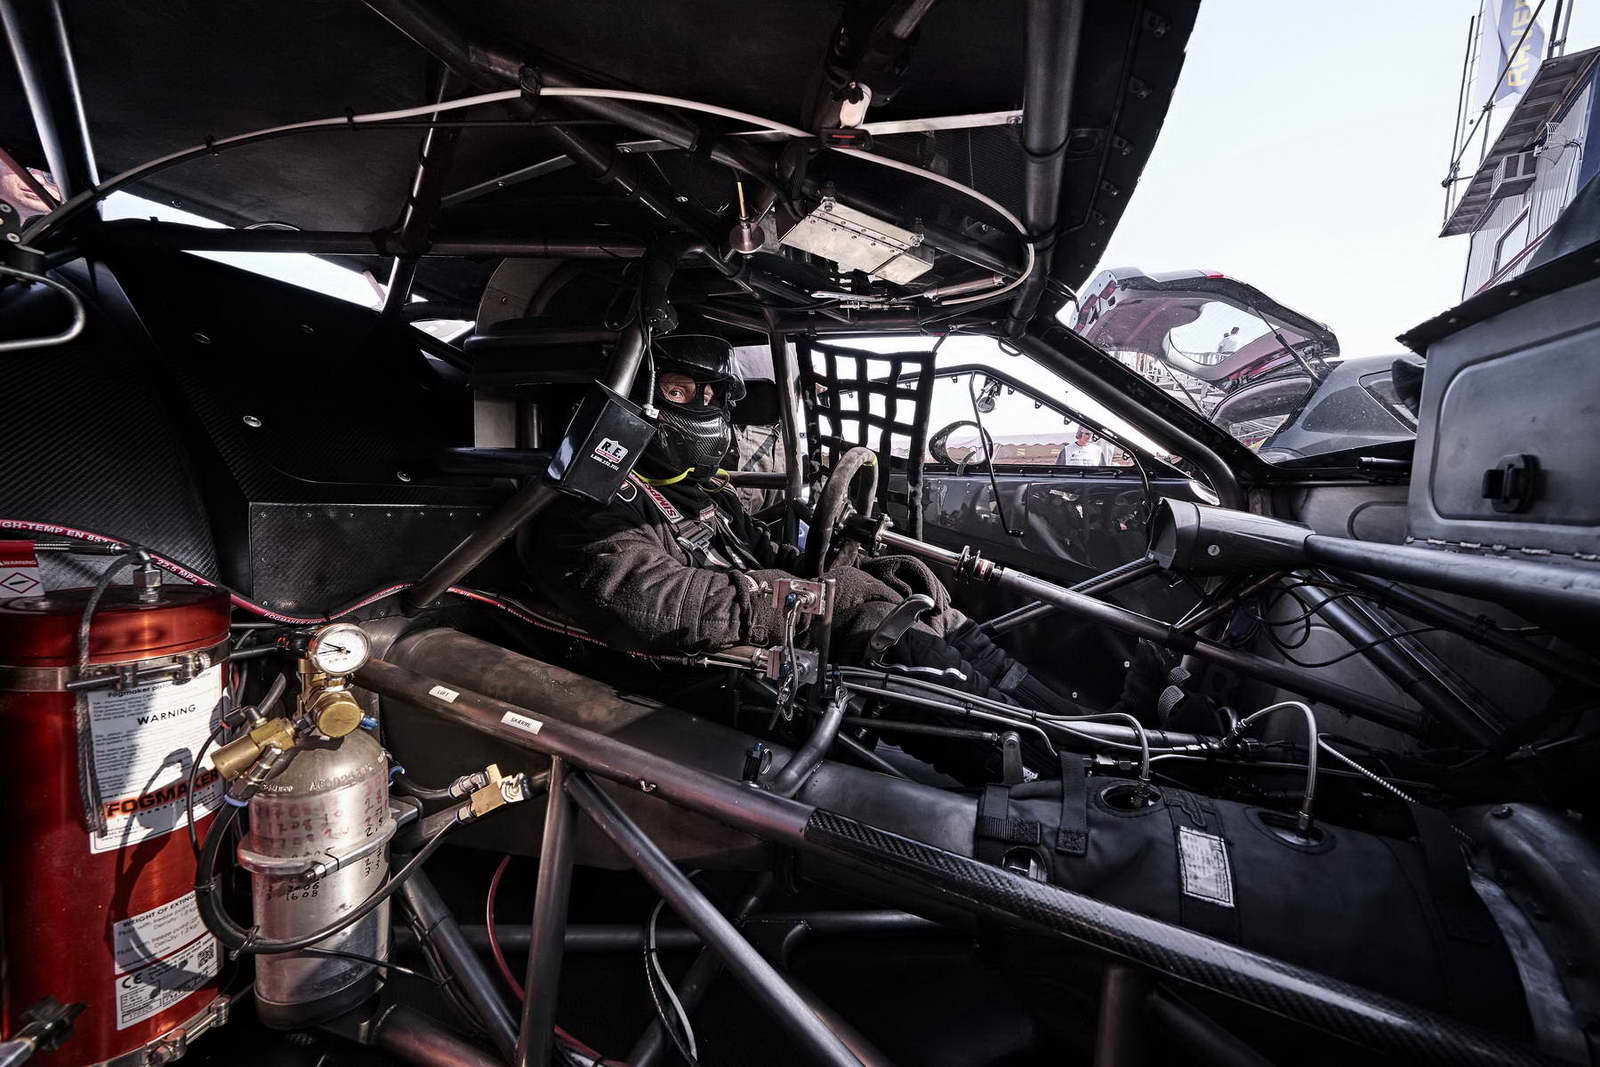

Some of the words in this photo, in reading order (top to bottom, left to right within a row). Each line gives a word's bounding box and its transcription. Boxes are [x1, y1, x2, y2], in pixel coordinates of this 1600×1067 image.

[66, 529, 84, 539] EN
[178, 570, 198, 584] MPa
[136, 704, 197, 726] WARNING
[105, 769, 220, 818] FOGMAKER
[157, 906, 169, 915] OF
